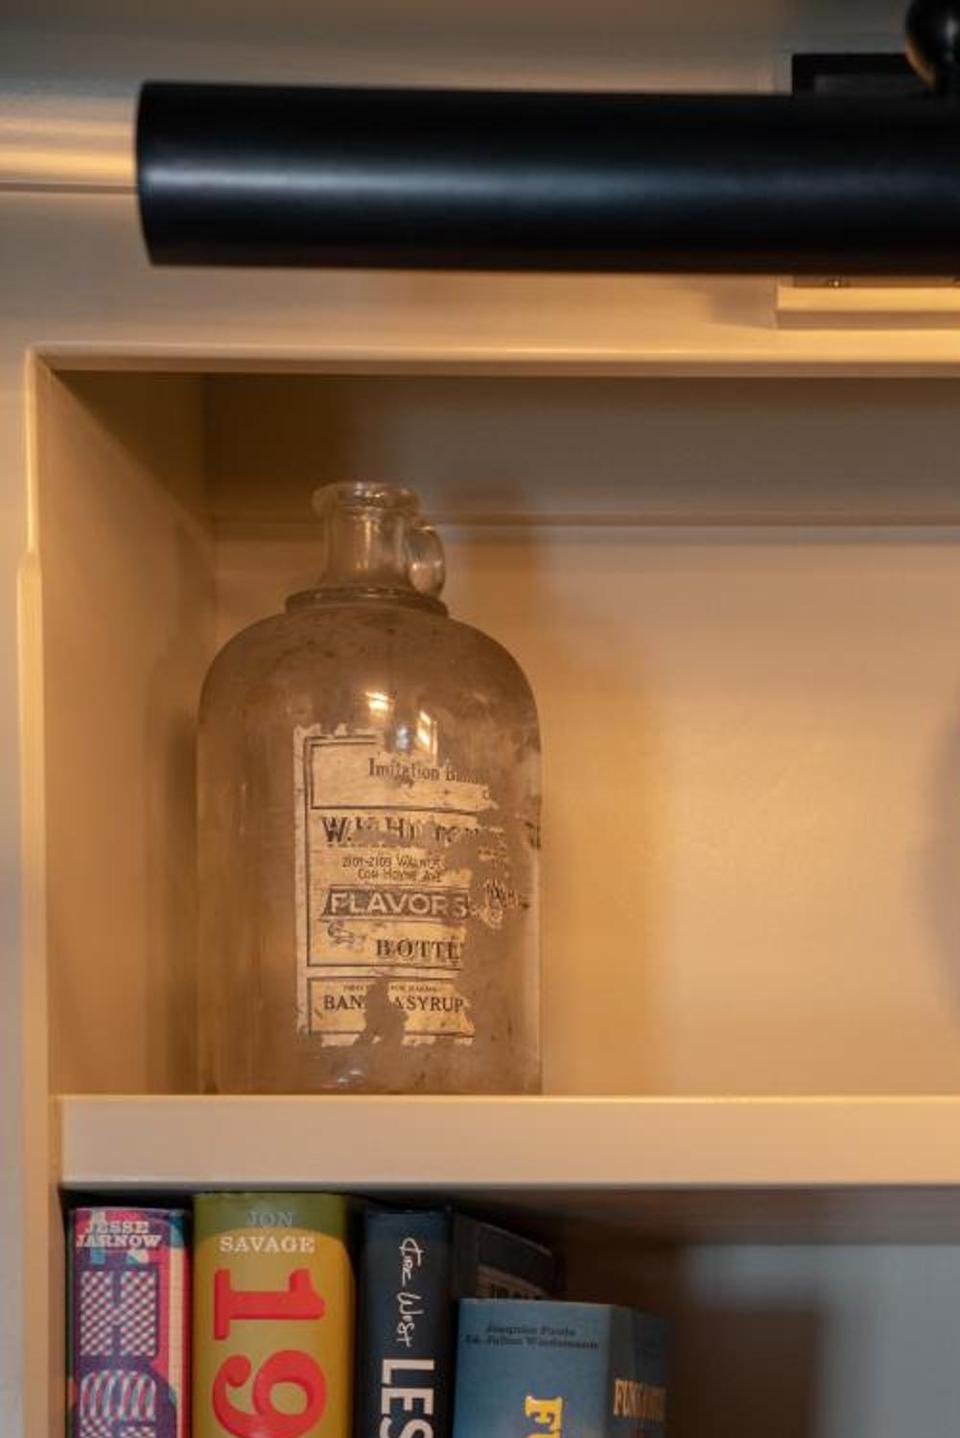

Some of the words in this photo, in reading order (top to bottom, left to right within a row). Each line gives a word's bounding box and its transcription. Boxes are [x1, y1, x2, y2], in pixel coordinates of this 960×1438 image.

[330, 892, 469, 918] FLAVORS
[406, 994, 464, 1013] SYRUP
[86, 1220, 149, 1235] JESSE
[248, 1211, 295, 1229] JON
[75, 1234, 162, 1249] JARNOW
[219, 1236, 316, 1255] SAVAGE
